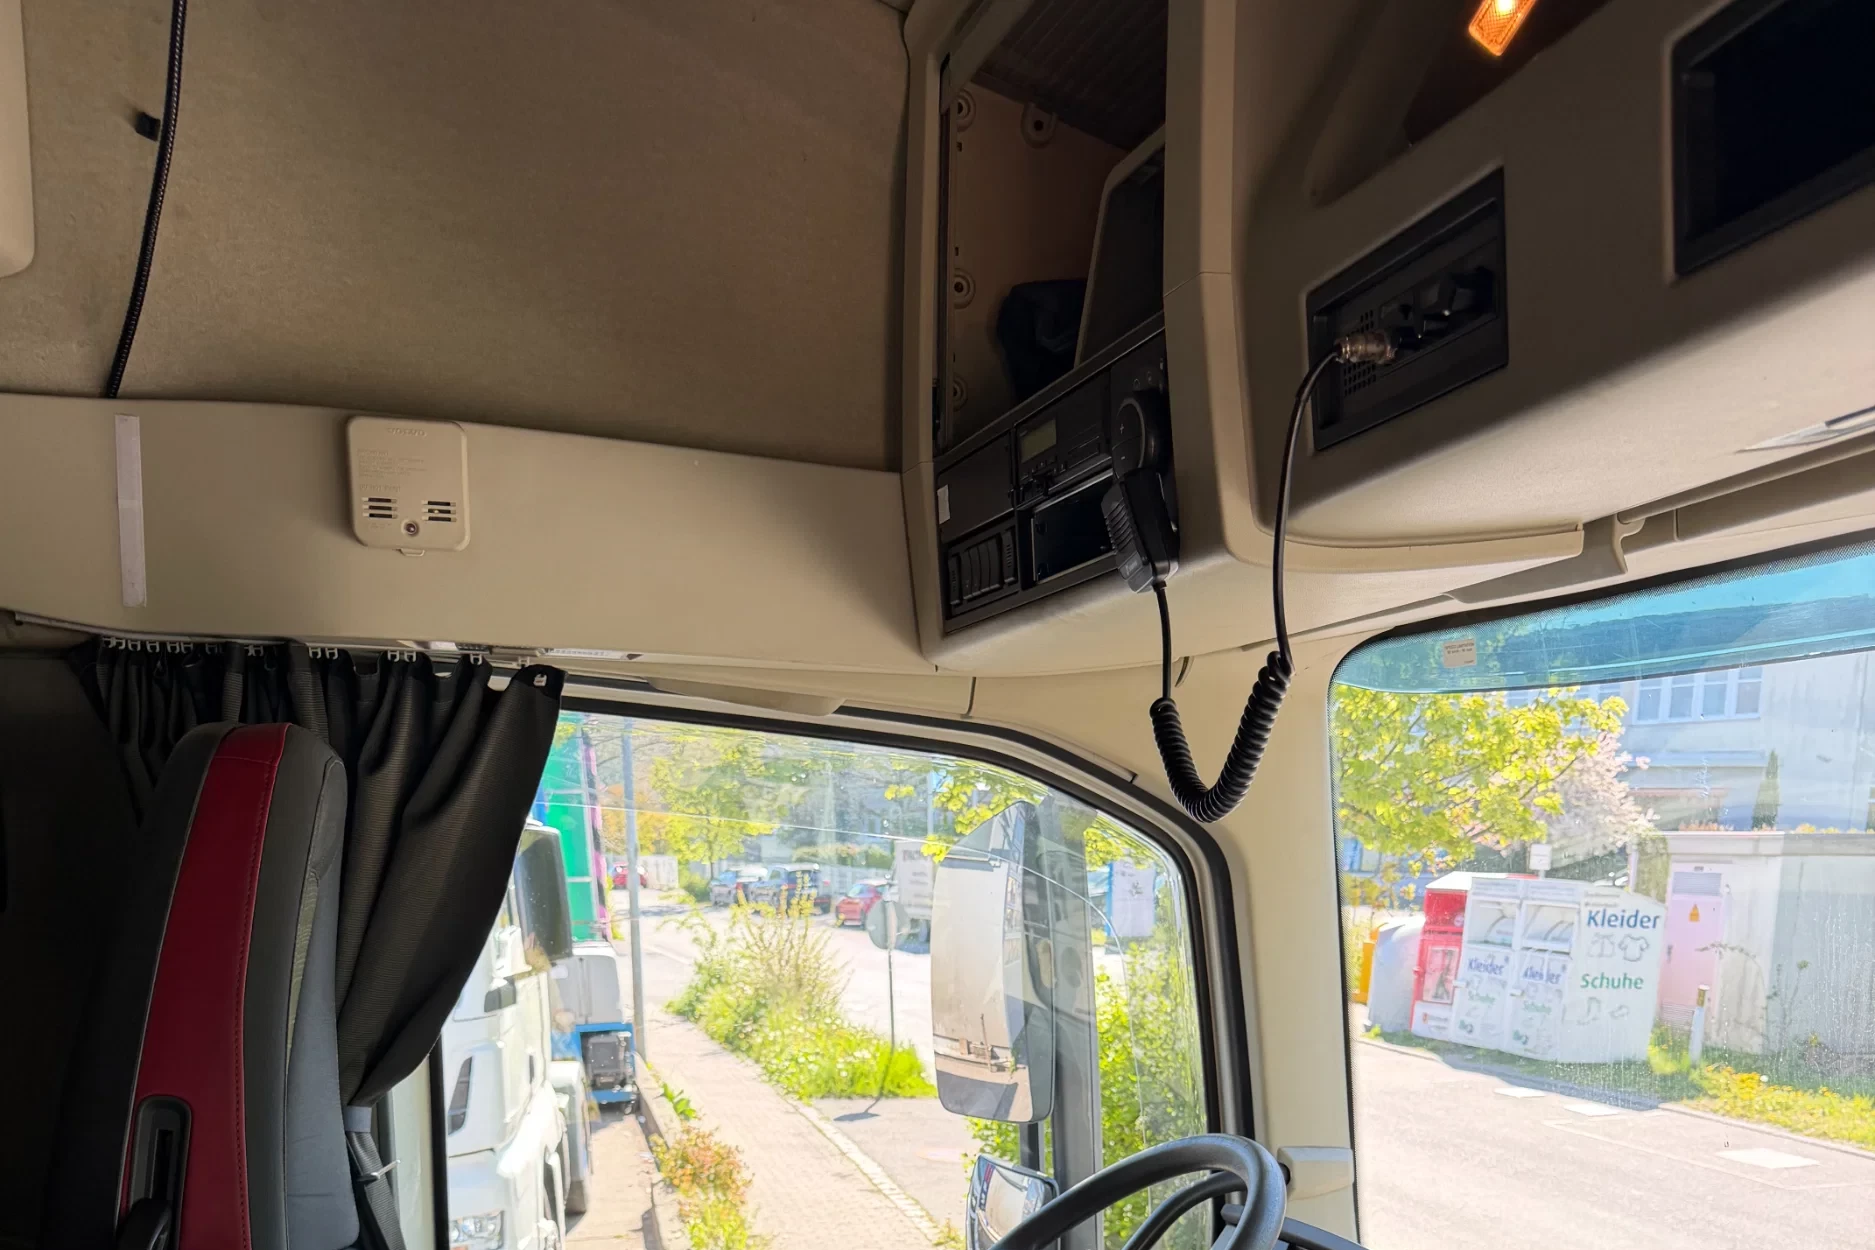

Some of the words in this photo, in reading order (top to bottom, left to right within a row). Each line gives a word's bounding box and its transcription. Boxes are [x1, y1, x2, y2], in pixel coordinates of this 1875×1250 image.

[1586, 908, 1661, 930] Kleider
[1467, 956, 1505, 976] Kleider
[1580, 972, 1644, 990] Schuhe
